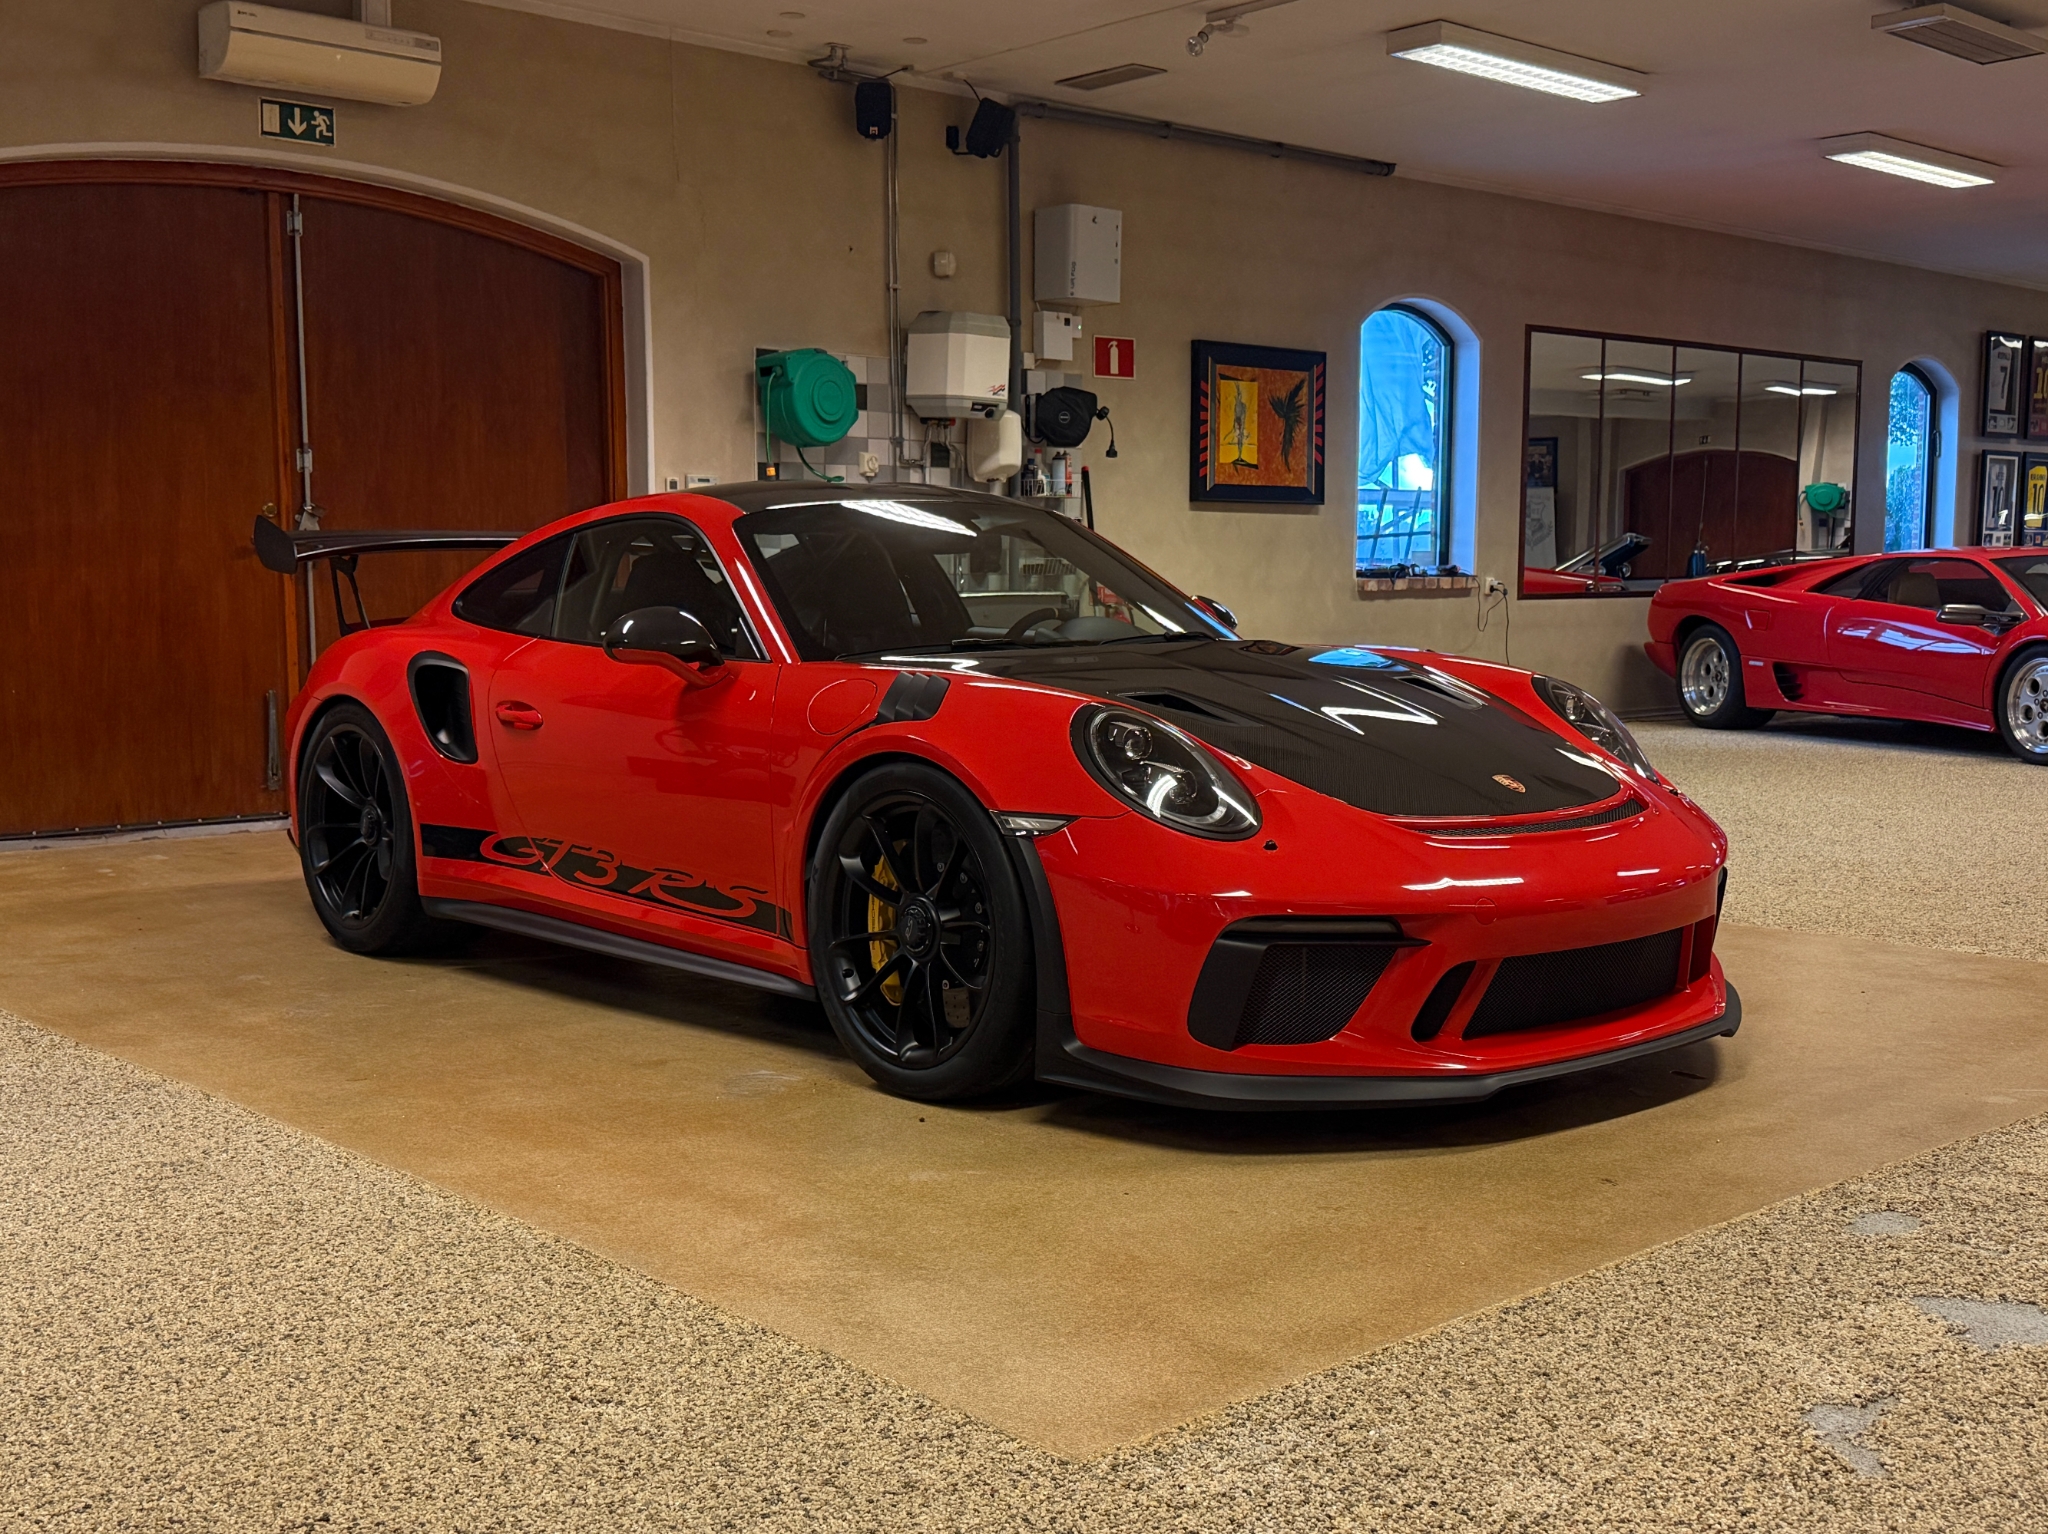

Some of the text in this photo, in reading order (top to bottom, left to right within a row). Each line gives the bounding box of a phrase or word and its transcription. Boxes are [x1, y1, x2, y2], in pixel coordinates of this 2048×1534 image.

[2000, 366, 2008, 399] 7
[2033, 484, 2045, 515] 10
[479, 833, 622, 885] GT3
[628, 866, 769, 918] RS
